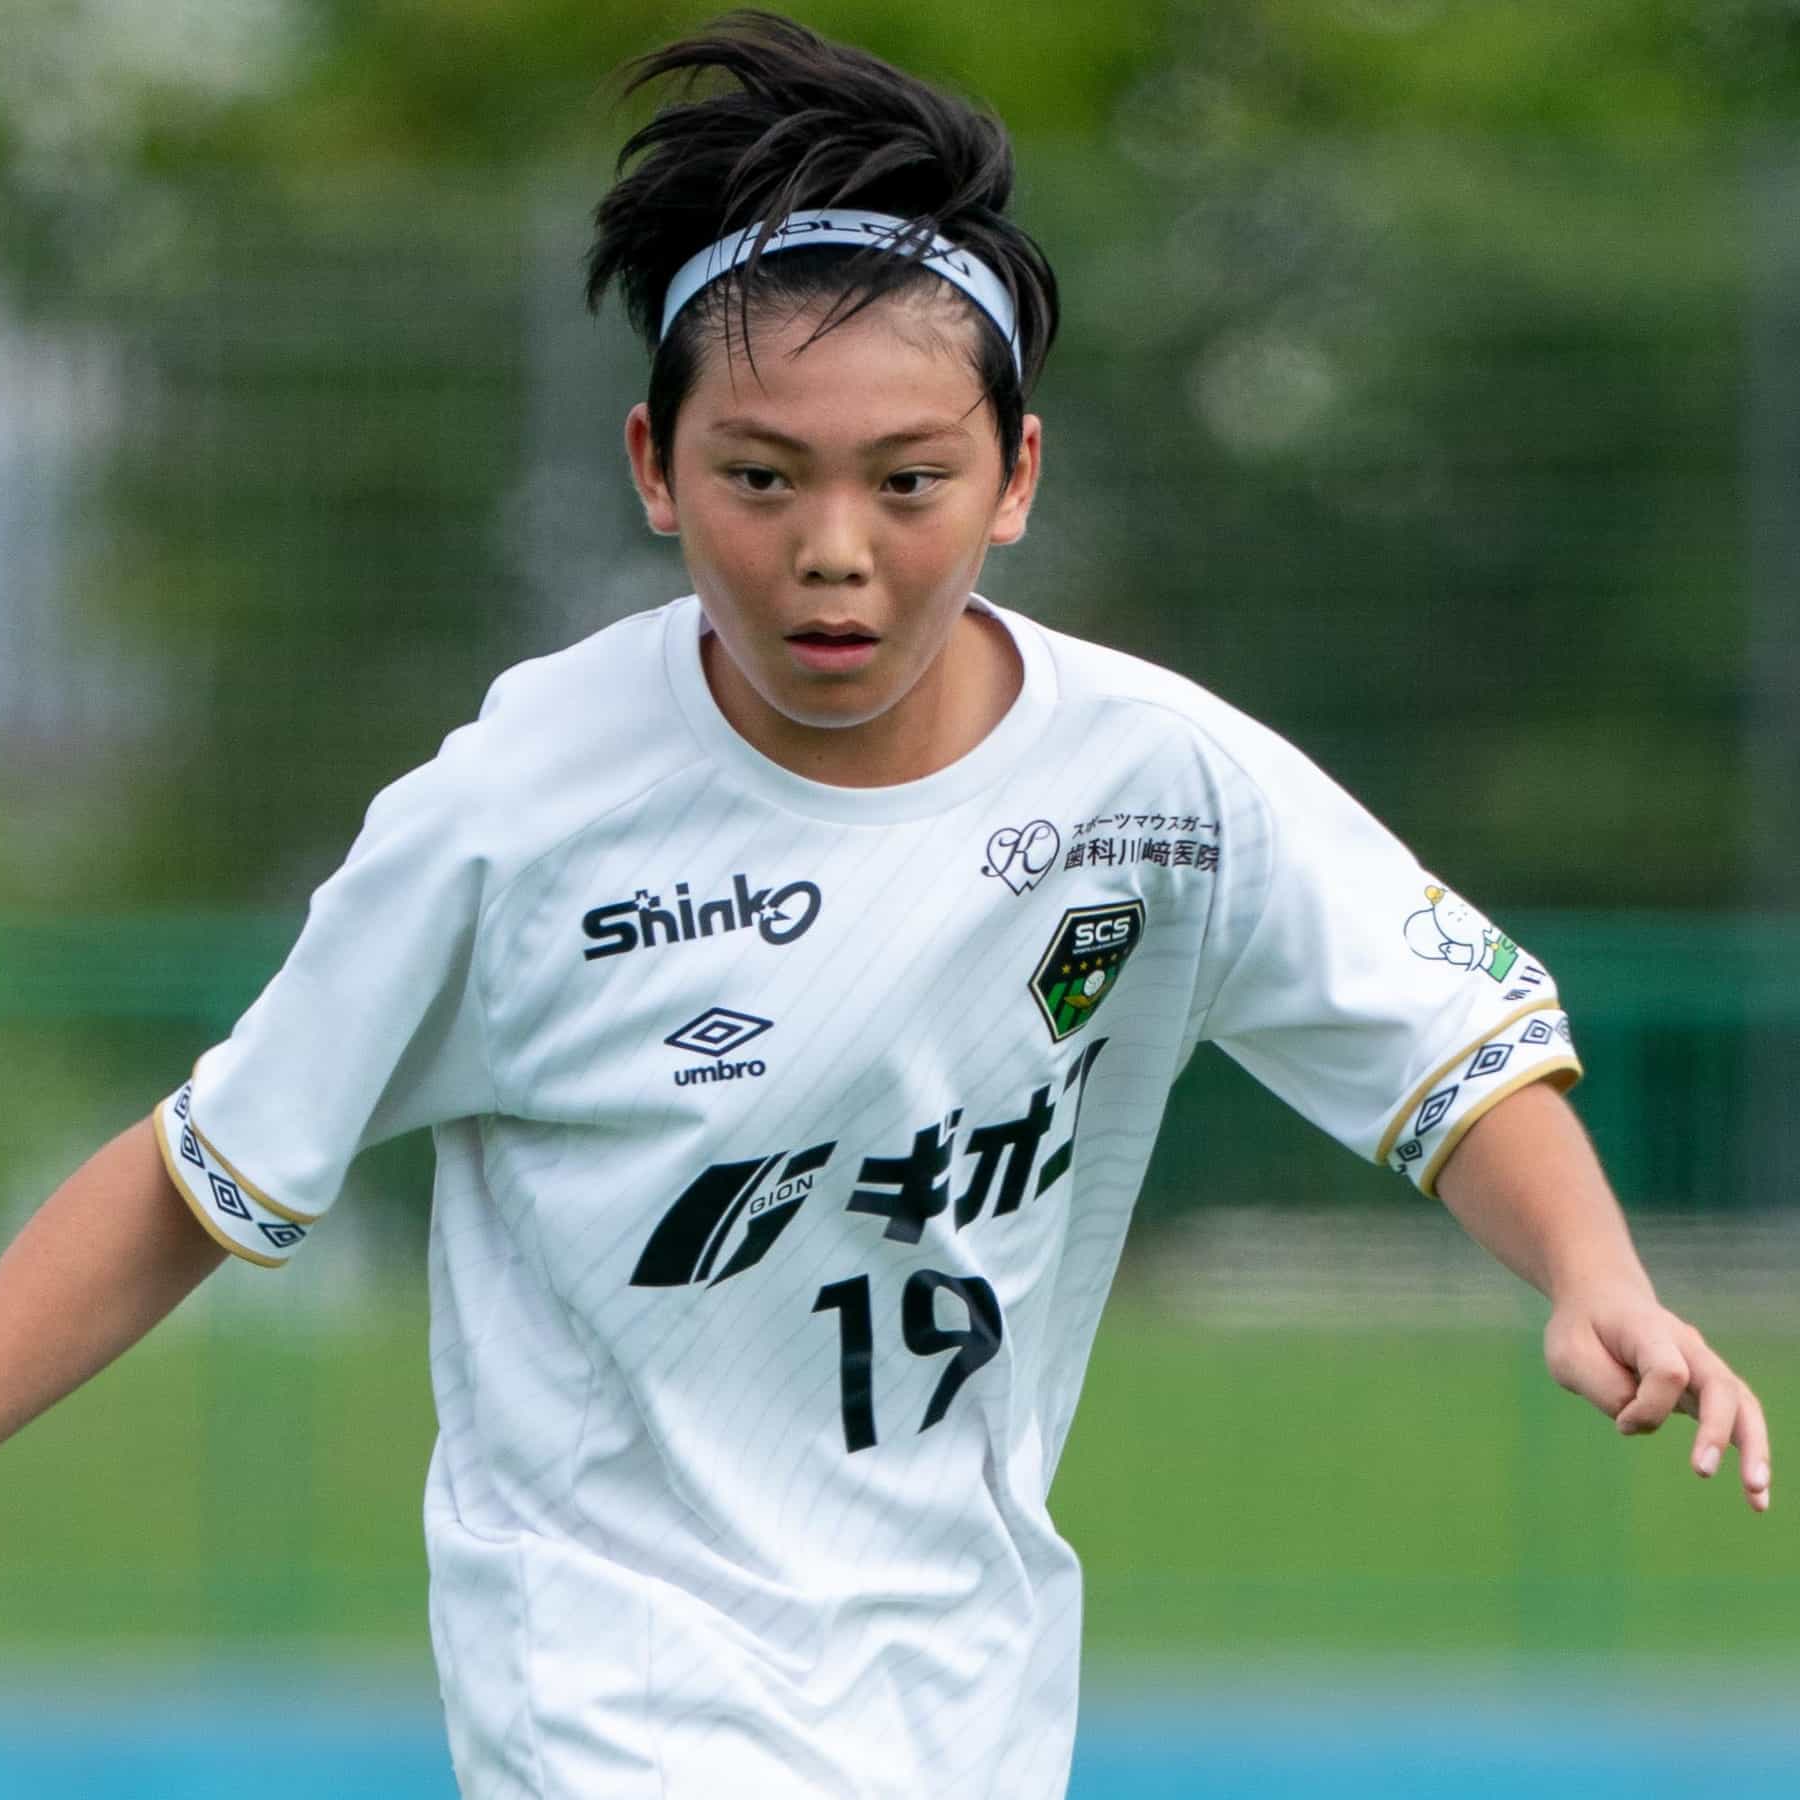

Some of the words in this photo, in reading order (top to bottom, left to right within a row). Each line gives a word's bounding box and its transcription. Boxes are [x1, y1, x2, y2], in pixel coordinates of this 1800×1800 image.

[1075, 916, 1131, 947] SCS
[674, 1059, 766, 1086] umbro
[749, 1174, 814, 1215] GION
[811, 1269, 1003, 1454] 19
